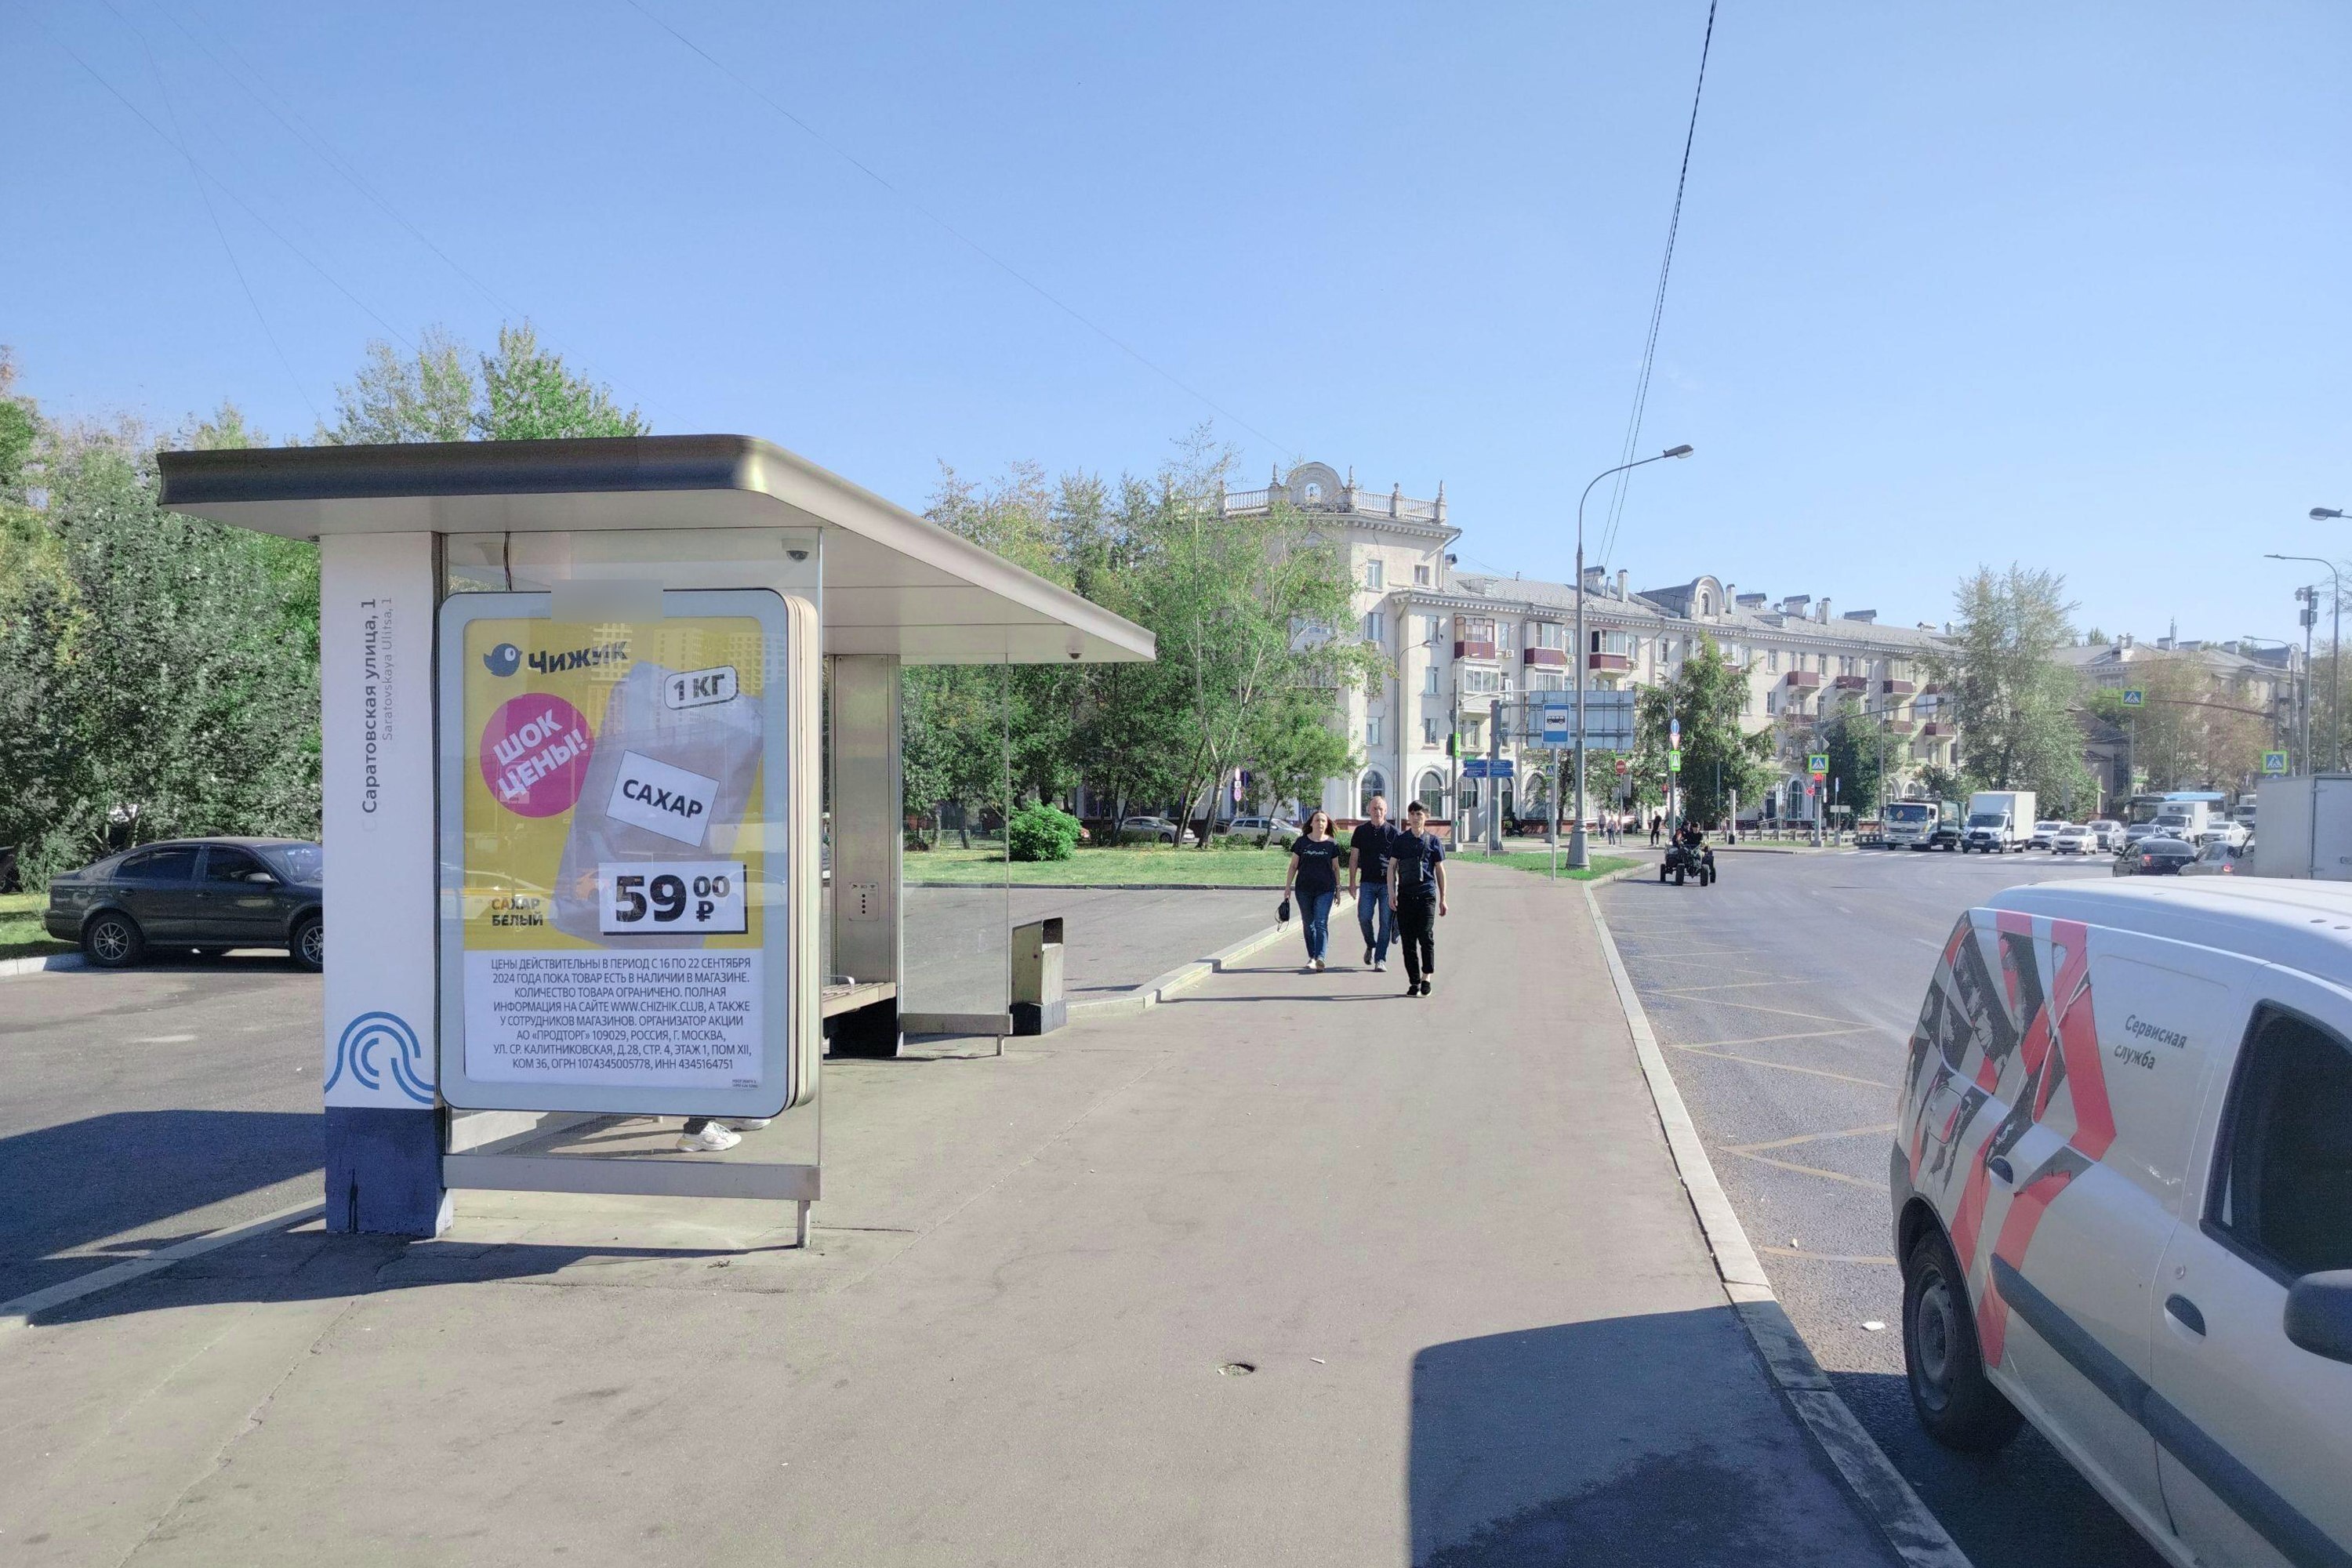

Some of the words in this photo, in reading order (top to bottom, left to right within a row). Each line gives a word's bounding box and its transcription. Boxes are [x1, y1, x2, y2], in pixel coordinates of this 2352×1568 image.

[361, 598, 376, 608] 1
[382, 608, 394, 651] Ulitsa,
[365, 615, 379, 680] улица,
[673, 680, 684, 701] 1
[693, 673, 725, 699] КГ
[382, 654, 394, 741] Saratovskaya
[492, 709, 562, 767] ШОК
[362, 686, 379, 814] Саратовская
[495, 728, 588, 800] ЦЕНЫ!
[622, 779, 703, 818] САХАР
[492, 898, 540, 910] САХАР
[615, 874, 687, 924] 59
[693, 875, 731, 898] 00
[492, 911, 543, 926] БЕЛЫЙ
[492, 959, 517, 971] ЦЕНЫ
[519, 956, 601, 971] ДЕЙСТВИТЕЛЬНЫ
[603, 959, 608, 969] В
[610, 958, 650, 971] ПЕРИОД
[652, 958, 658, 969] С
[659, 958, 670, 969] 16
[672, 958, 687, 969] ПО
[688, 958, 700, 969] 22
[701, 957, 751, 969] СЕНТЯБРЯ
[492, 973, 515, 984] 2024
[517, 973, 541, 985] ГОДА
[543, 973, 570, 984] ПОКА
[572, 973, 603, 984] ТОВАР
[604, 973, 626, 984] ЕСТЬ
[628, 973, 634, 983] В
[637, 972, 684, 983] НАЛИЧИИ
[687, 972, 693, 983] В
[695, 972, 750, 983] МАГАЗИНЕ.
[514, 987, 576, 998] КОЛИЧЕСТВО
[578, 987, 614, 998] ТОВАРА
[615, 987, 683, 998] ОГРАНИЧЕНО.
[684, 987, 727, 997] ПОЛНАЯ
[493, 1001, 561, 1013] ИНФОРМАЦИЯ
[564, 1001, 577, 1012] НА
[579, 1000, 609, 1012] САЙТЕ
[611, 1001, 707, 1013] WWW.CHIZHIK.CLUB,
[708, 1001, 716, 1011] А
[717, 1001, 750, 1011] ТАКЖЕ
[500, 1016, 506, 1026] У
[508, 1016, 575, 1028] СОТРУДНИКОВ
[576, 1016, 637, 1026] МАГАЗИНОВ.
[638, 1015, 706, 1026] ОРГАНИЗАТОР
[708, 1015, 744, 1028] АКЦИИ
[2125, 1014, 2187, 1049] Сервисная
[516, 1030, 530, 1040] АО
[532, 1030, 590, 1042] «ПРОДТОРГ»
[593, 1030, 629, 1042] 109029,
[630, 1030, 672, 1042] РОССИЯ,
[673, 1030, 680, 1040] Г.
[681, 1030, 726, 1042] МОСКВА,
[493, 1044, 508, 1054] УЛ.
[510, 1044, 522, 1054] СР.
[524, 1044, 615, 1056] КАЛИТНИКОВСКАЯ,
[643, 1044, 662, 1054] СТР.
[663, 1044, 673, 1056] 4,
[674, 1044, 701, 1055] ЭТАЖ
[702, 1044, 710, 1056] 1,
[712, 1044, 735, 1055] ПОМ
[2114, 1044, 2156, 1069] служба
[513, 1058, 535, 1069] КОМ
[535, 1058, 550, 1070] 36,
[551, 1058, 576, 1069] ОГРН
[579, 1058, 653, 1070] 1074345005778,
[655, 1059, 677, 1069] ИНН
[678, 1059, 734, 1069] 4345164751
